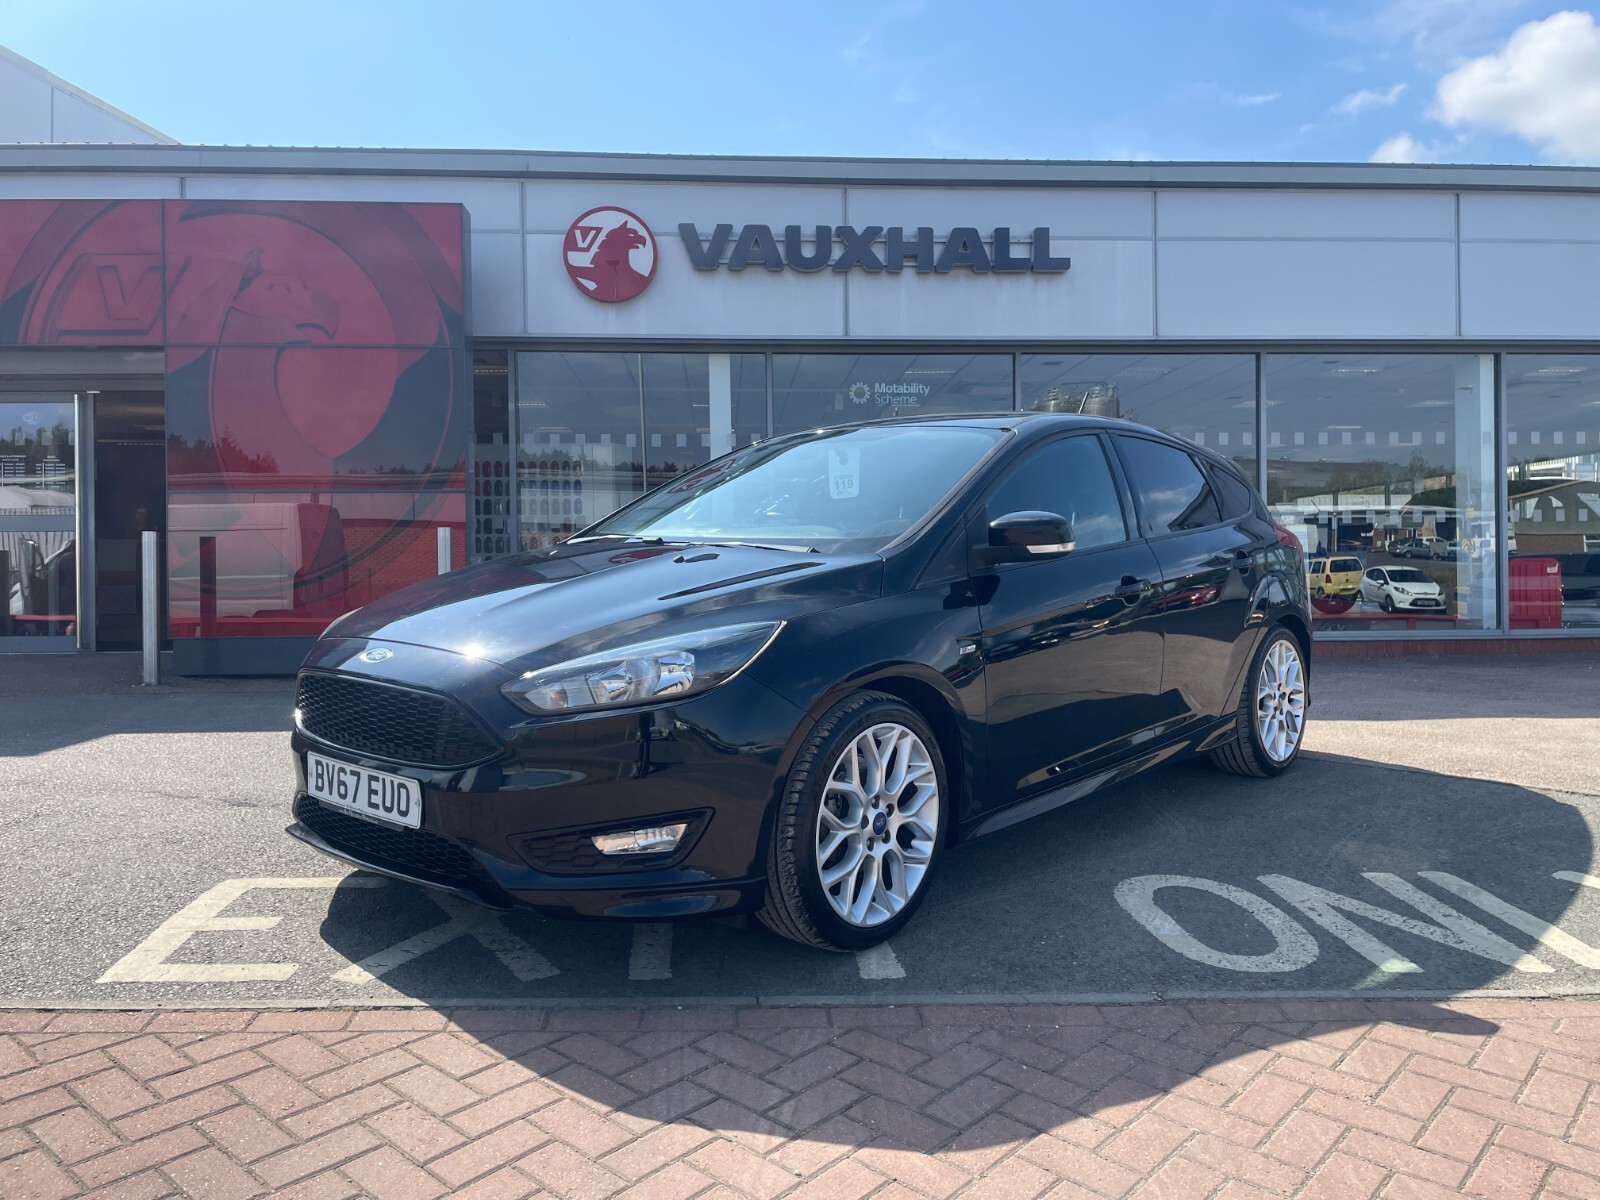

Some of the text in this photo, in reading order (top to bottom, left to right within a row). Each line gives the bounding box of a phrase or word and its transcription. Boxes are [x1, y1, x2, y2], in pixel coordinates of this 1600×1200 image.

[574, 229, 597, 248] V
[678, 222, 1071, 274] VAUXHALL
[874, 382, 931, 396] Motability
[874, 393, 918, 404] Scheme
[833, 479, 854, 490] 119
[314, 758, 361, 804] BV67
[367, 773, 411, 818] EUO
[95, 870, 1600, 985] EXI ONL
